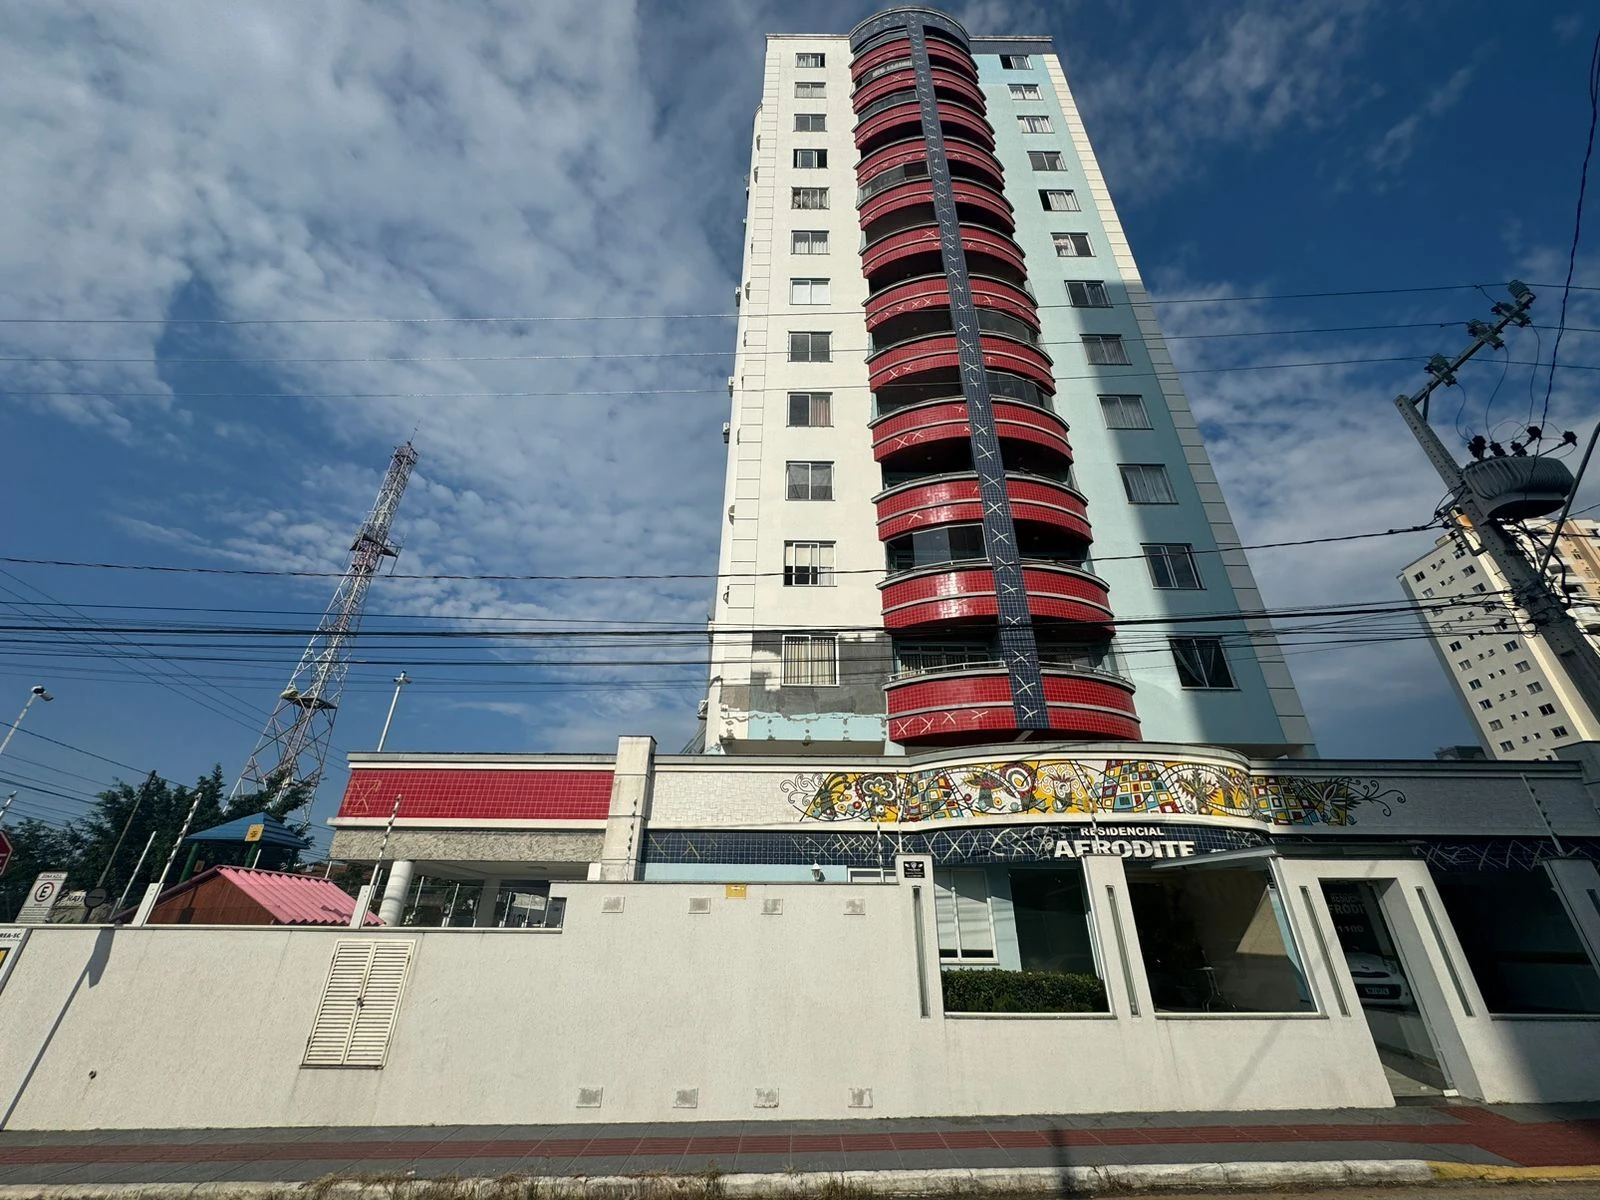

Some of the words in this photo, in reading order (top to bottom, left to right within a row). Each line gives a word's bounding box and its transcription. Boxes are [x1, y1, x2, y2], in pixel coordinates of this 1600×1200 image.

[1080, 827, 1164, 836] RESIDENCIAL
[1054, 840, 1195, 858] AFRODITE
[39, 886, 50, 898] E
[1329, 904, 1365, 914] FRODI
